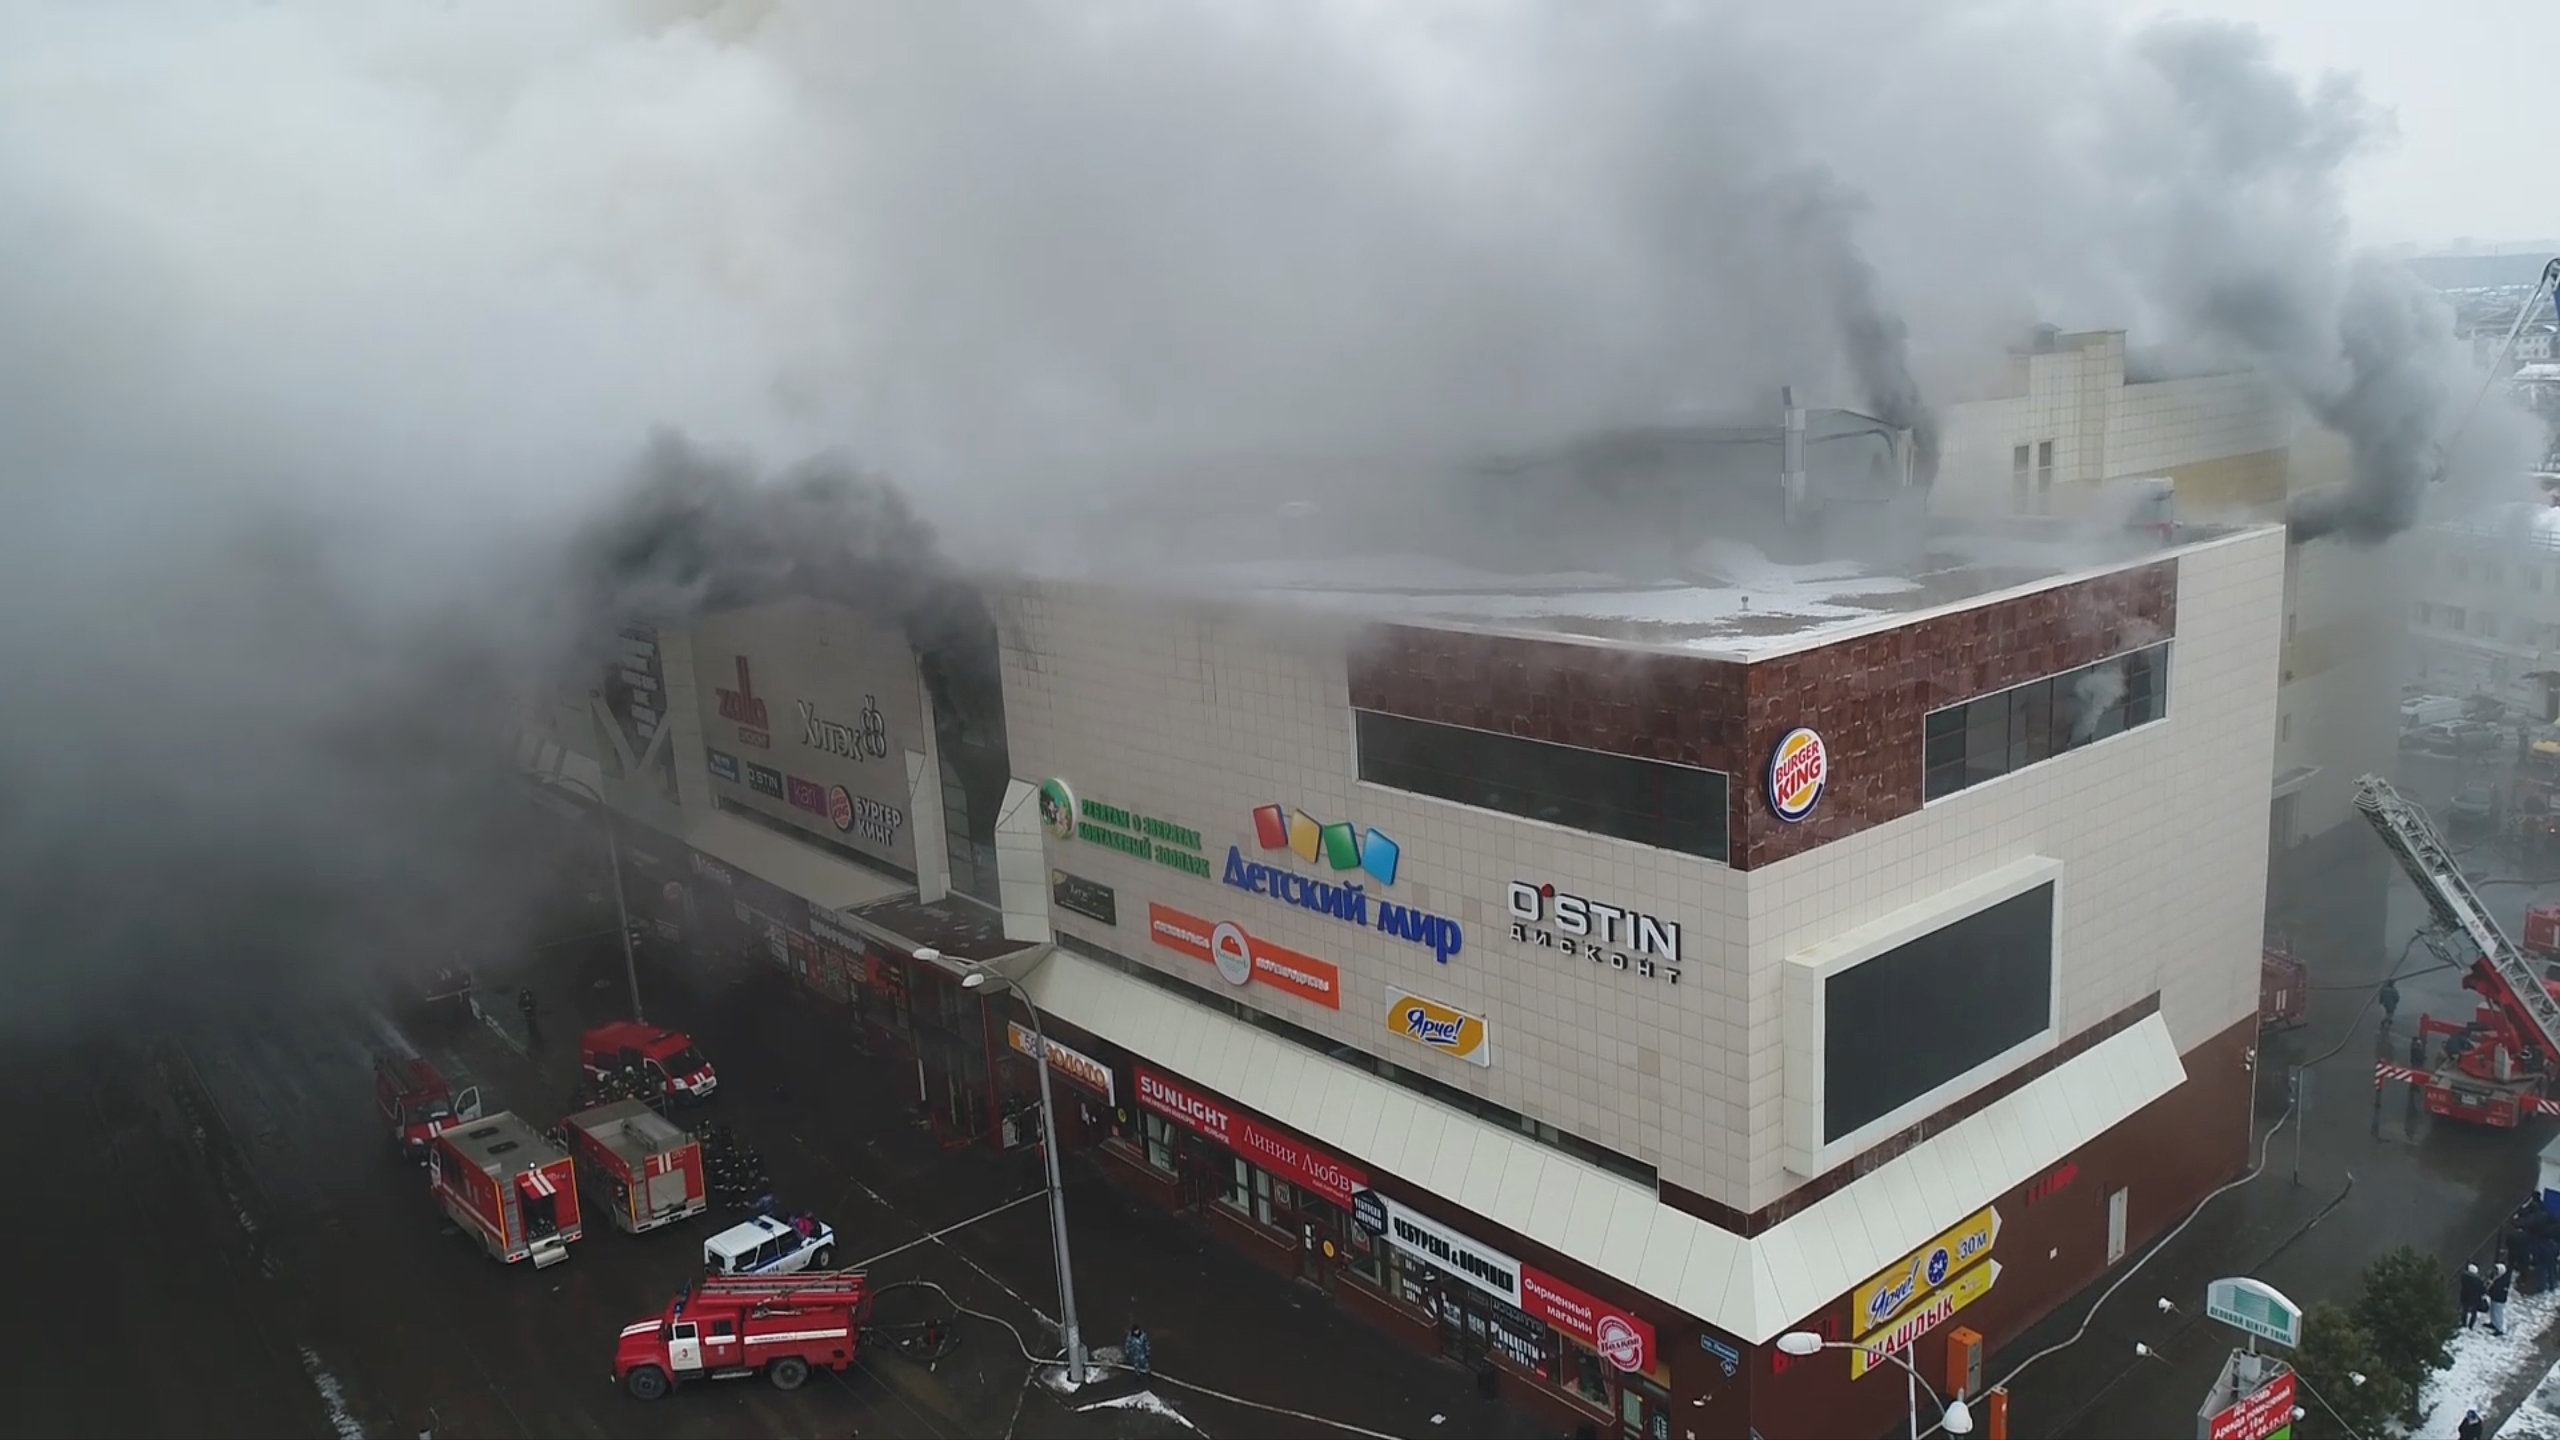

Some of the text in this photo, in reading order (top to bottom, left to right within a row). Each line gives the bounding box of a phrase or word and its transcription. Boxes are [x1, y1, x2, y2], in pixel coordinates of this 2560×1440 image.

[1775, 739, 1819, 784] BURGER
[1777, 756, 1822, 806] KING
[855, 796, 902, 828] БУРГЕР
[858, 819, 893, 846] КИНГ
[1155, 845, 1211, 879] ЗООПАРК
[1222, 845, 1462, 964] Детский мир
[1509, 923, 1681, 985] ДИСКОНТ
[1406, 1008, 1465, 1043] Ярче!
[1046, 1043, 1106, 1088] ЗОЛОТО
[1140, 1075, 1229, 1131] SUNLIGHT
[1243, 1124, 1297, 1166] Линии
[1393, 1216, 1451, 1262] ЧЕБУРЕКИ
[1523, 1277, 1593, 1321] Фирменный
[1870, 1257, 1921, 1325] Ярче!
[1546, 1303, 1593, 1336] магазин
[1866, 1294, 1954, 1370] ШАШЛЫК
